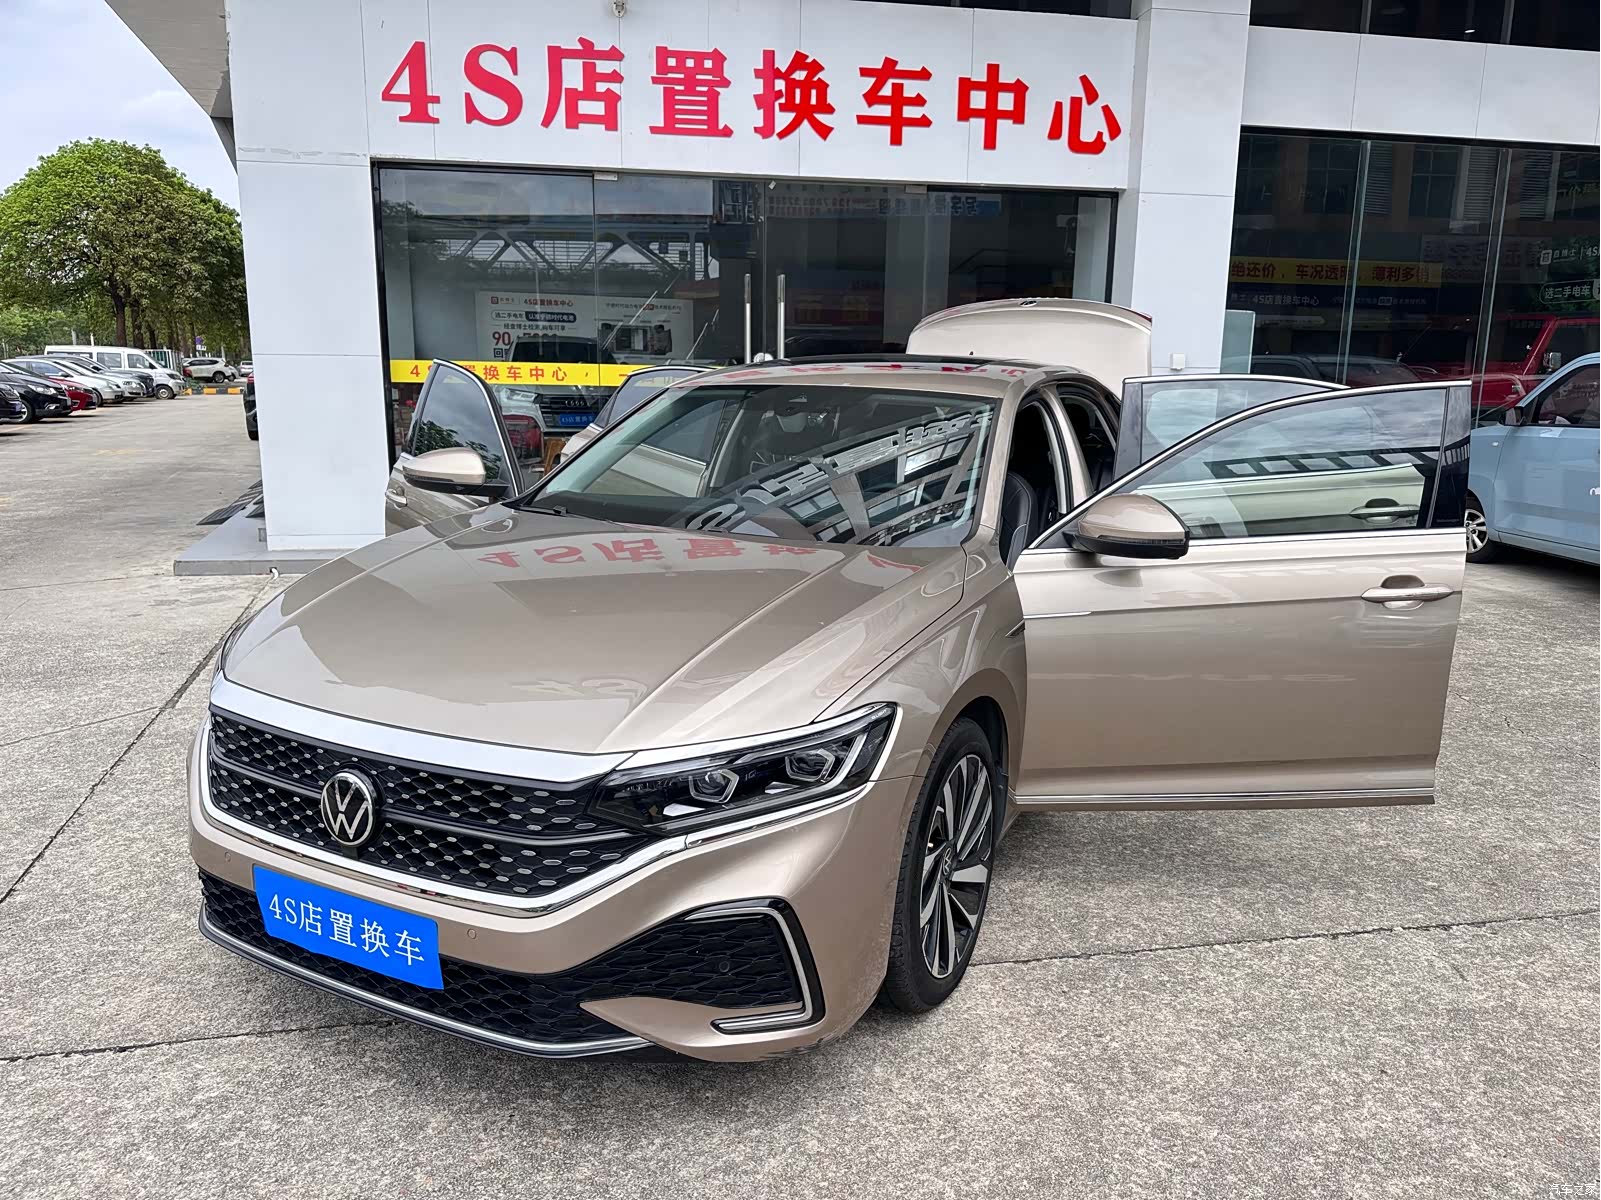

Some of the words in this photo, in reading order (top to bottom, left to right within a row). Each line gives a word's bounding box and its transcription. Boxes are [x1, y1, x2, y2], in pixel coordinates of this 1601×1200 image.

[381, 37, 1122, 155] 4S店置换车中心
[268, 893, 425, 966] 4S店置换车
